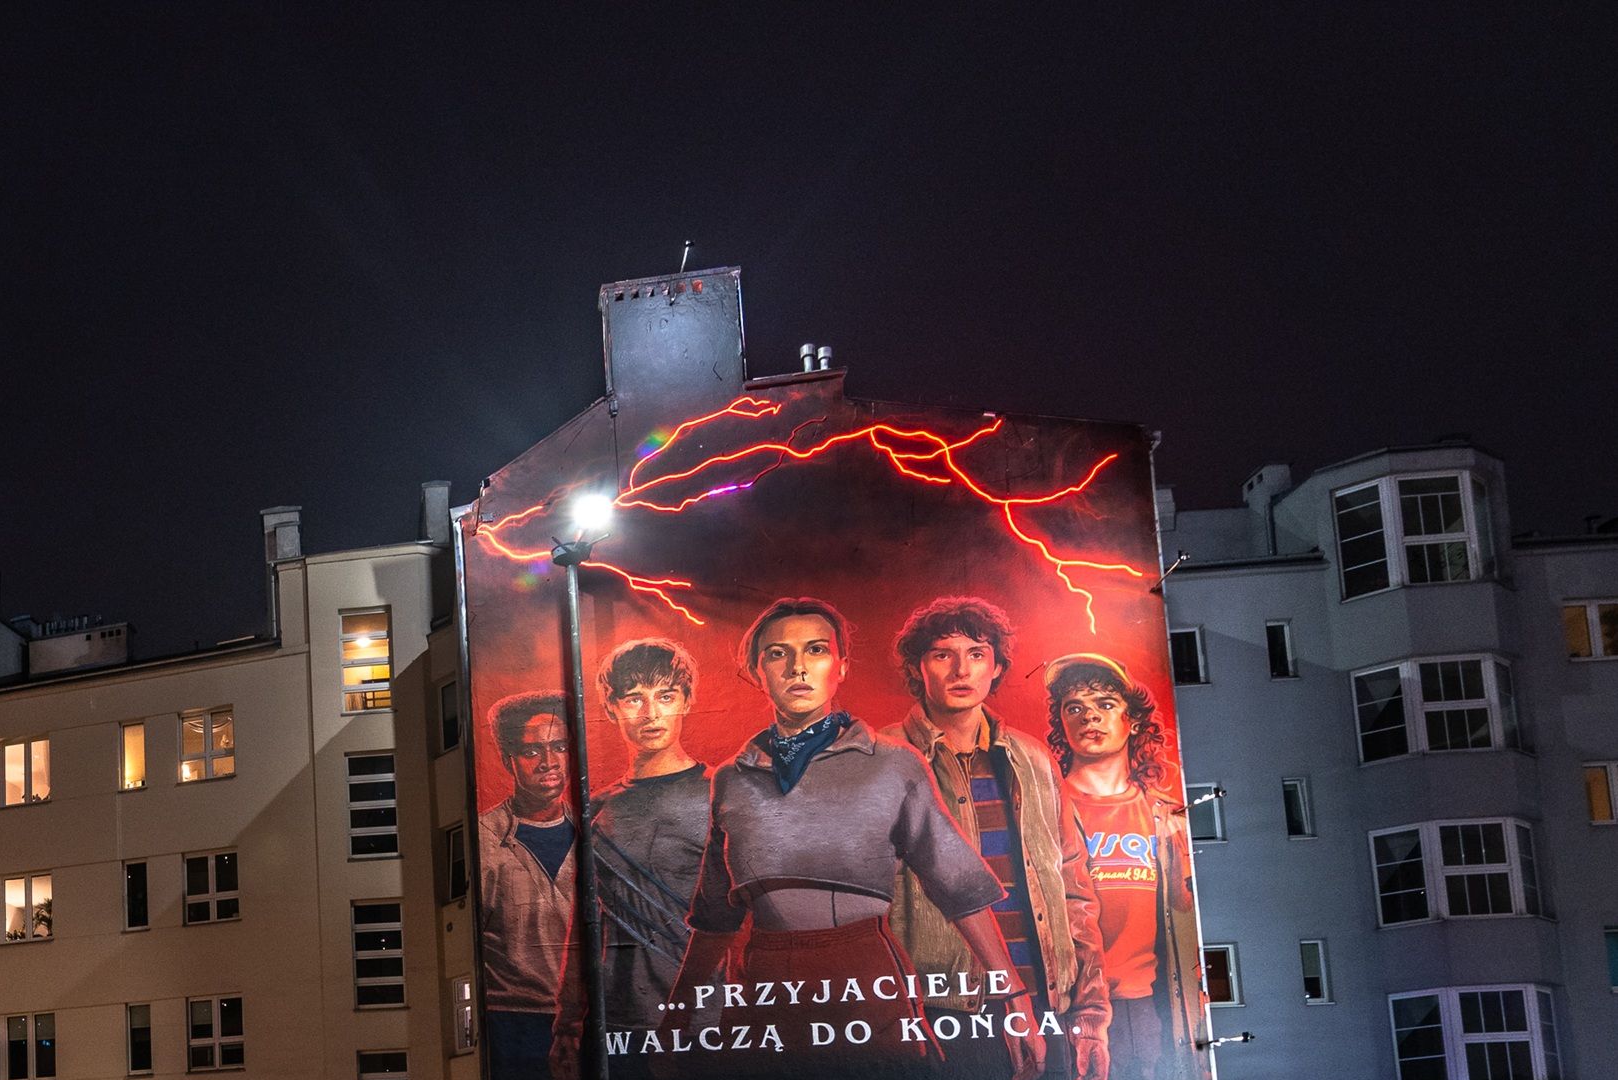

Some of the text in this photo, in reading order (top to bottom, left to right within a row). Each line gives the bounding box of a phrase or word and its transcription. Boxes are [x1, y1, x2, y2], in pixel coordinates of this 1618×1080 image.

[1090, 866, 1156, 881] Squawk 94.5
[658, 969, 1012, 1011] ...PRZYJACIELE
[605, 1004, 1082, 1055] WALCZĄ DO KOŃCA.
